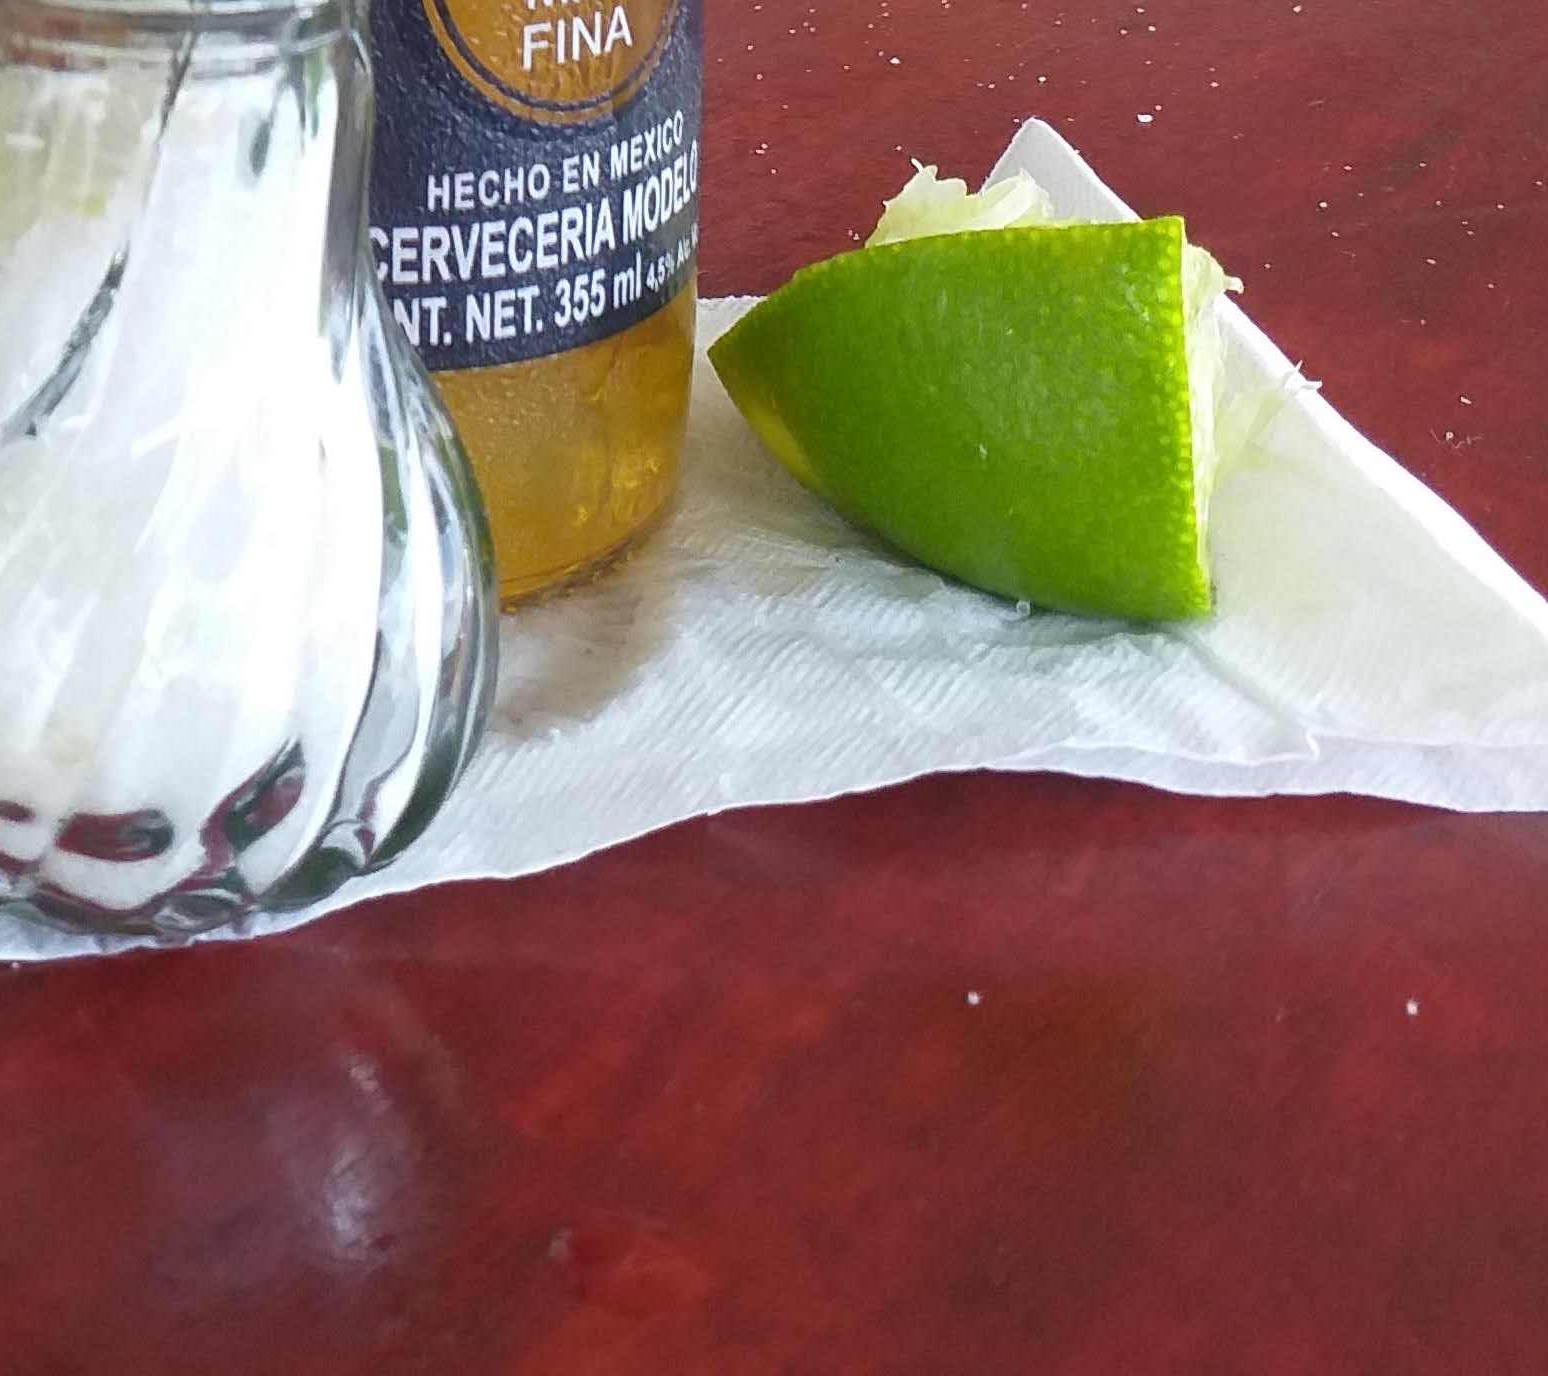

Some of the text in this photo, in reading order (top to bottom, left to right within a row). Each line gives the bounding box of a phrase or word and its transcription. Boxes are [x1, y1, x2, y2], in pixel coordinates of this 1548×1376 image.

[523, 5, 633, 71] FINA
[427, 109, 684, 213] HECHO EN MEXICO
[368, 139, 698, 286] CERVECERIA MODELO
[394, 296, 452, 347] NT.
[466, 285, 543, 344] NET.
[554, 268, 606, 328] 355
[613, 251, 642, 309] ml
